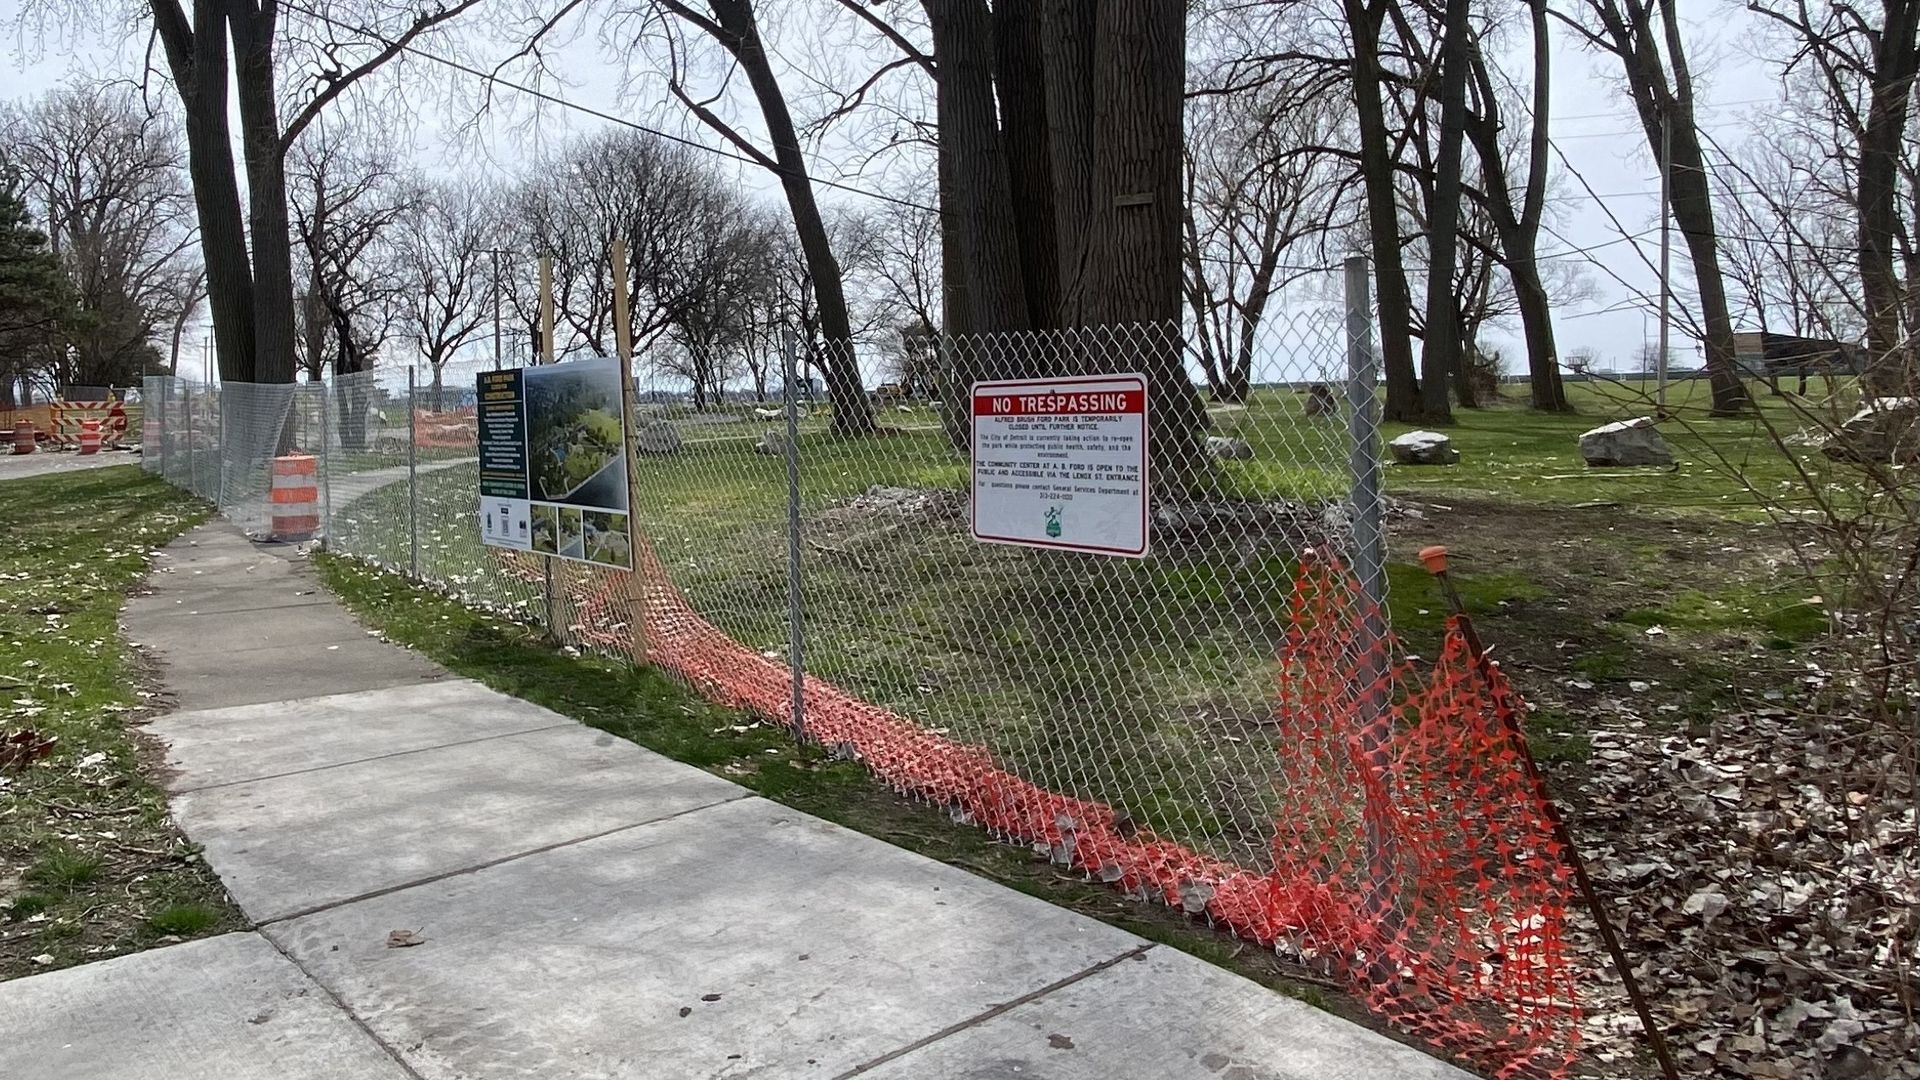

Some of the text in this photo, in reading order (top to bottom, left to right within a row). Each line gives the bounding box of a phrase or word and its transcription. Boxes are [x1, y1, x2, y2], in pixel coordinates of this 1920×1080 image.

[993, 394, 1126, 413] NO TRESPASSING
[1098, 487, 1129, 495] Department
